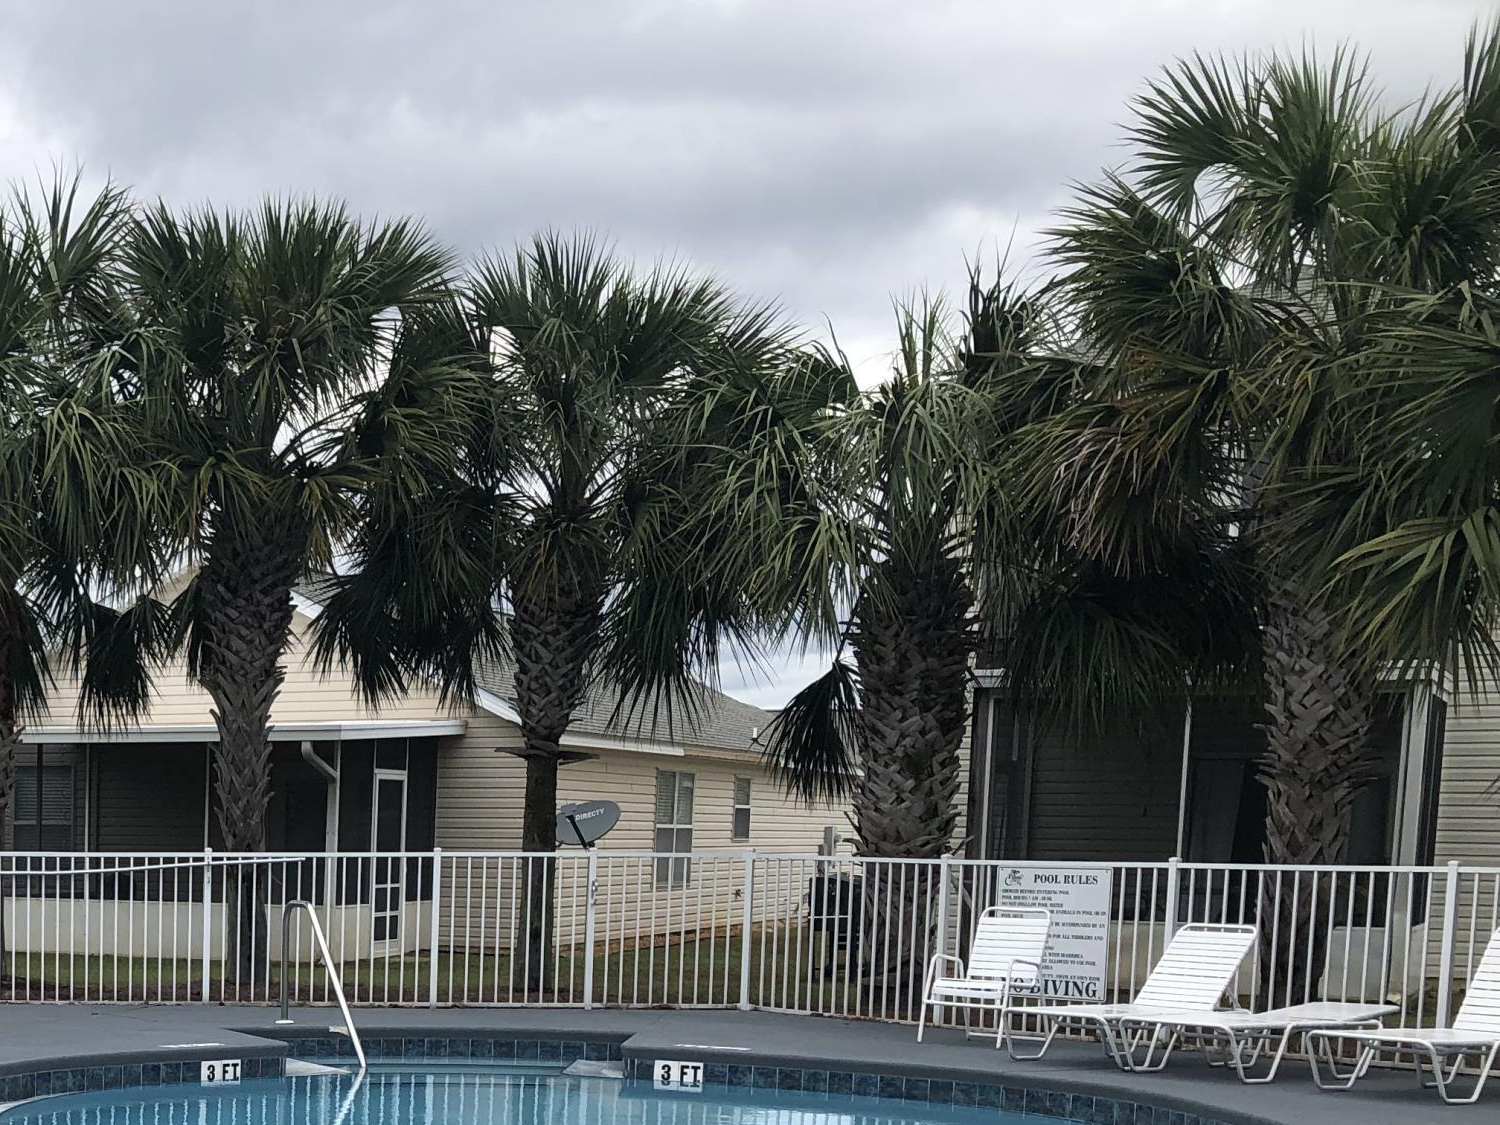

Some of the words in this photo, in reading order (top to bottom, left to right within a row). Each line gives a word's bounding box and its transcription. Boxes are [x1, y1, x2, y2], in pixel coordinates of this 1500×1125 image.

[575, 807, 605, 821] DIRECTV
[1033, 873, 1061, 885] POOL
[1063, 874, 1099, 886] RULES
[207, 1064, 215, 1082] 3
[661, 1064, 671, 1082] 3
